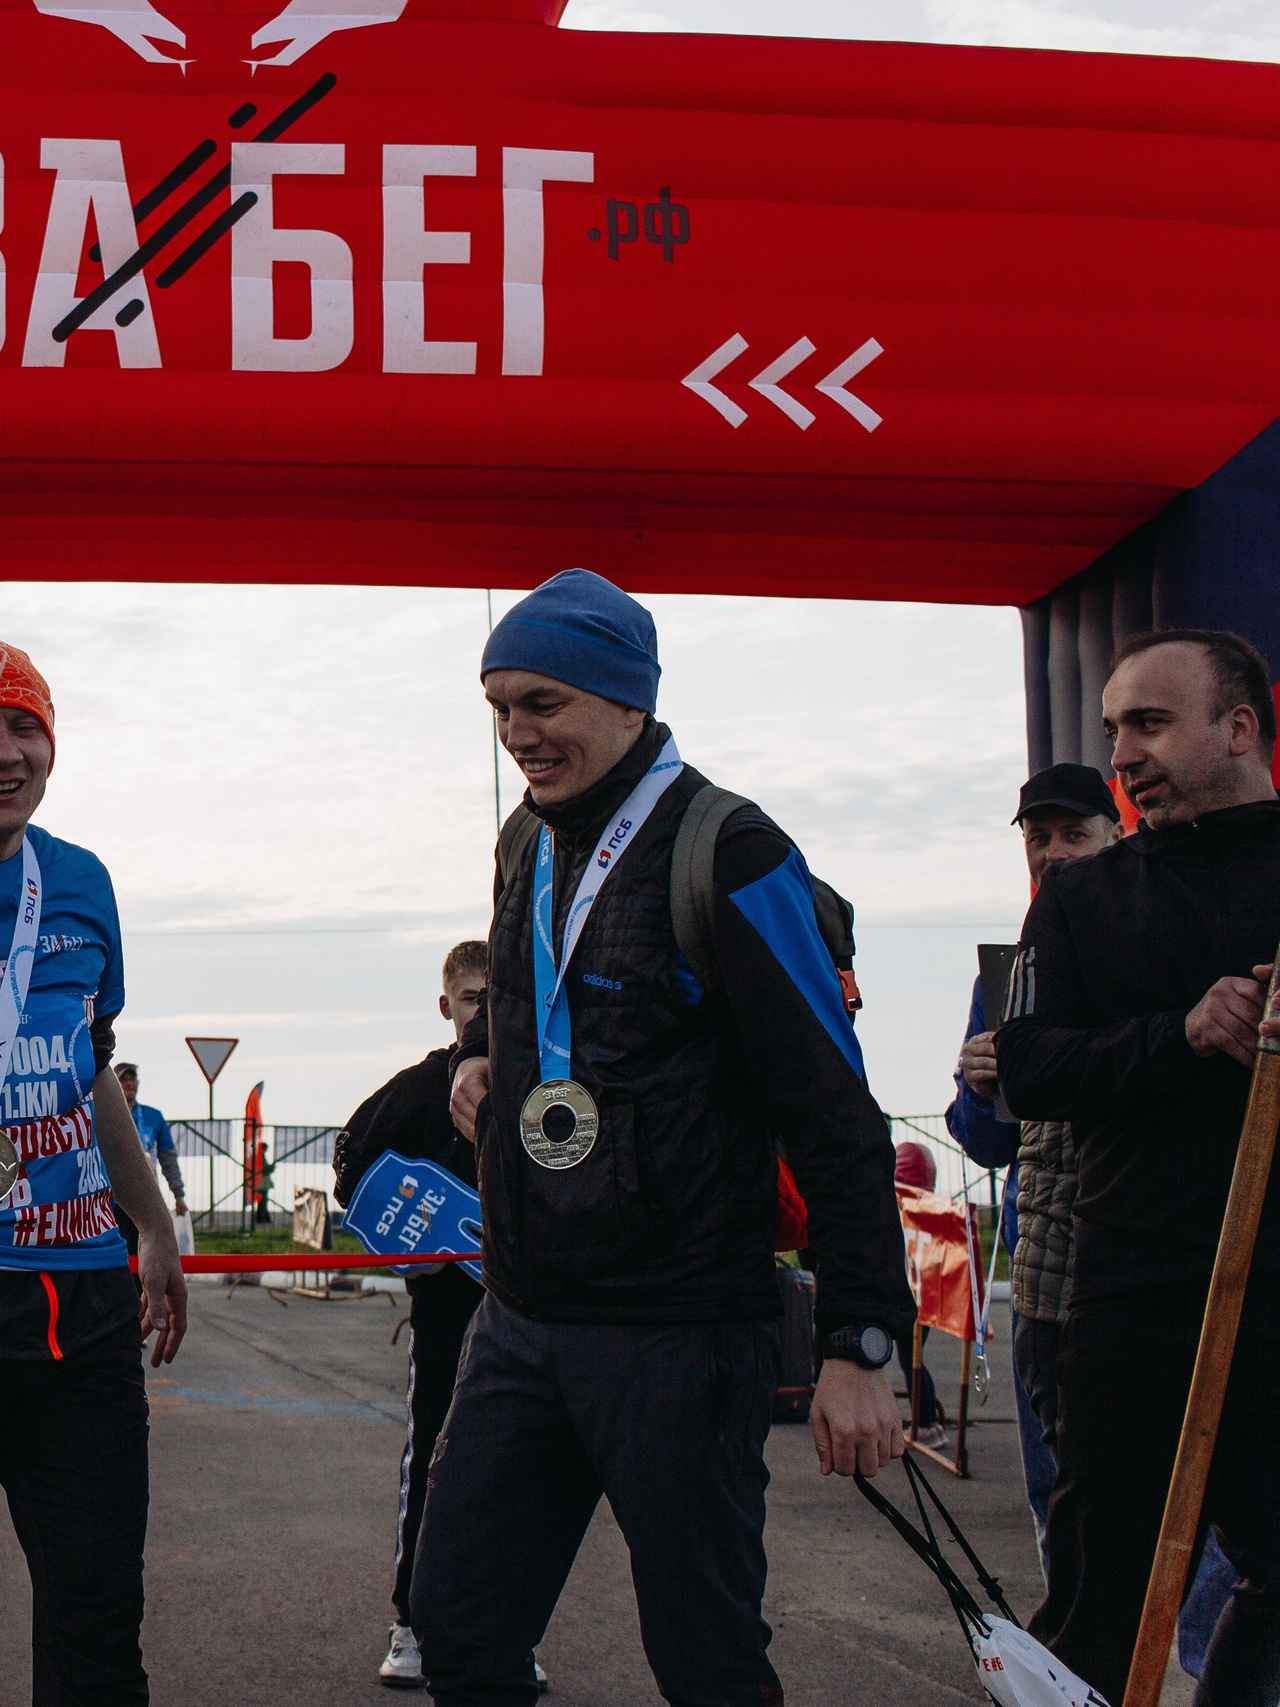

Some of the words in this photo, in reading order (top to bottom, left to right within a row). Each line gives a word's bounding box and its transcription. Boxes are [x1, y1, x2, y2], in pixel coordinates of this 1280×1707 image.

[607, 818, 633, 850] ПСБ
[540, 835, 551, 867] ПСБ
[24, 896, 36, 925] ПСБ
[582, 973, 614, 990] adidas
[375, 1196, 404, 1237] ПСБ
